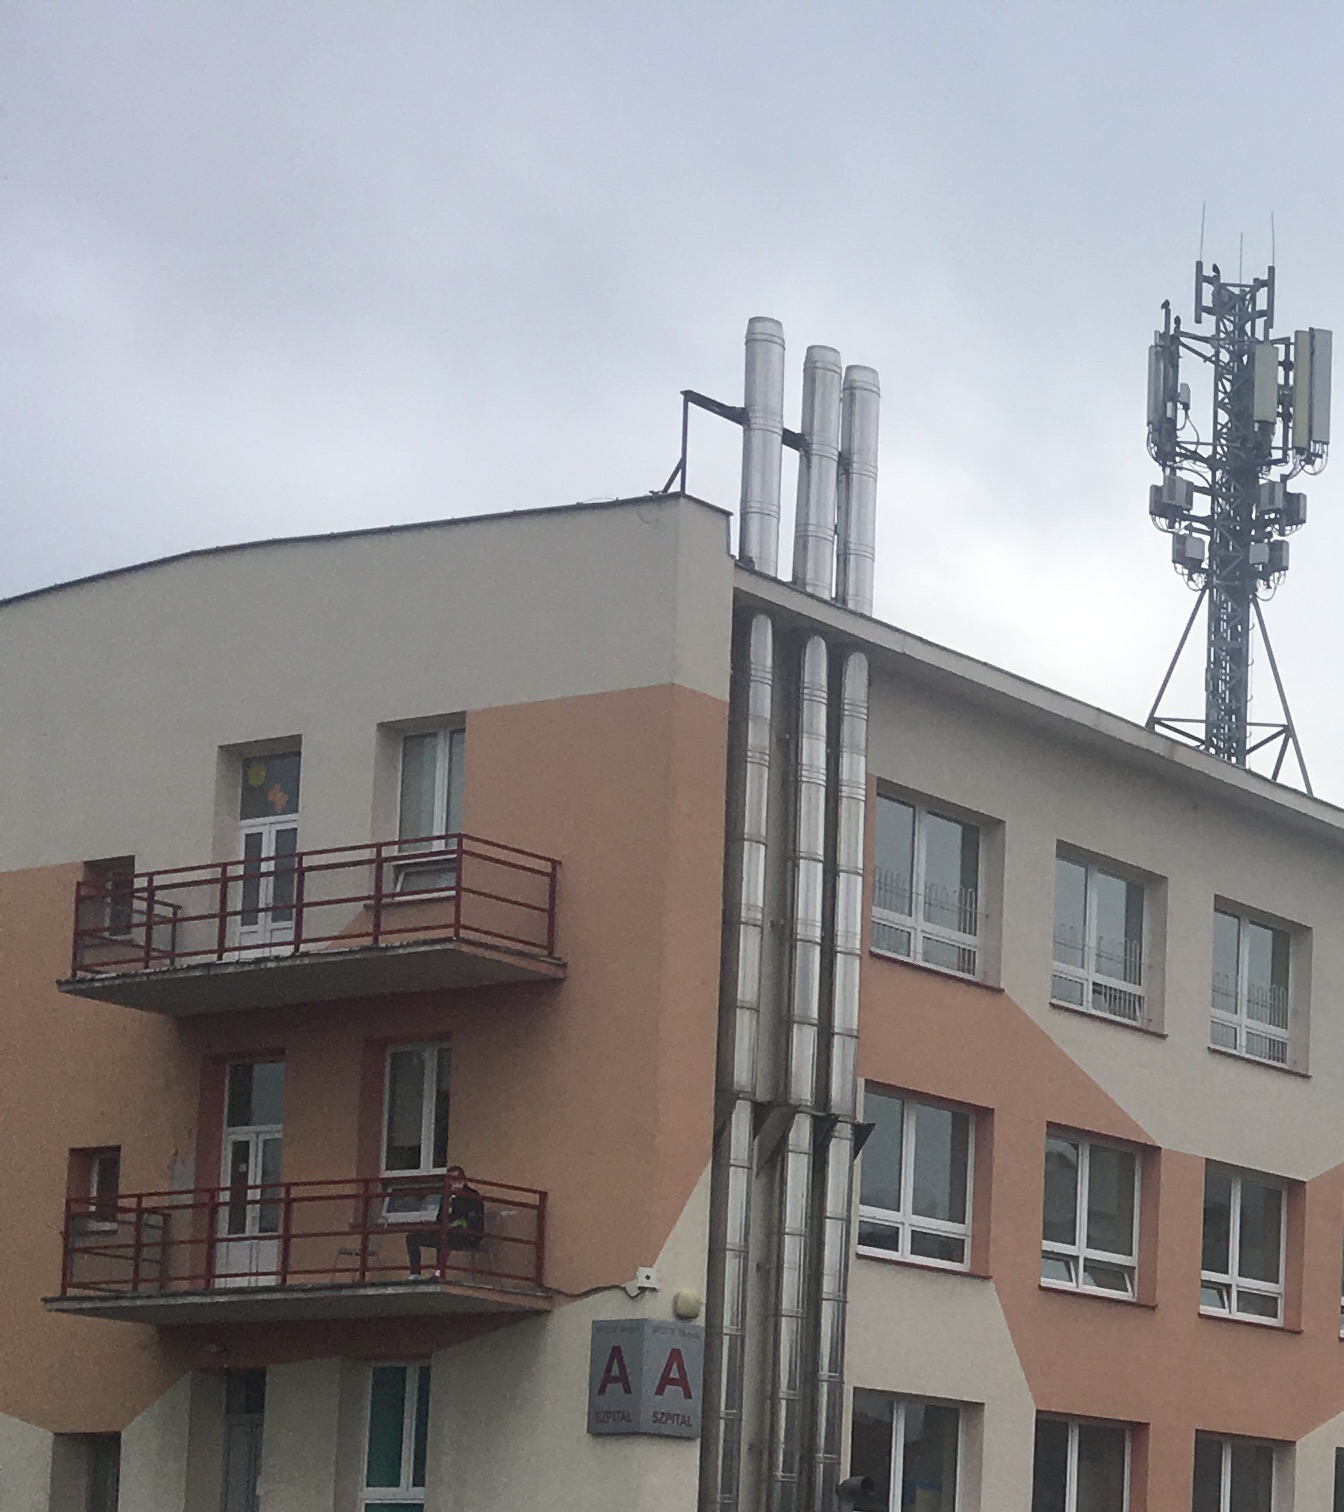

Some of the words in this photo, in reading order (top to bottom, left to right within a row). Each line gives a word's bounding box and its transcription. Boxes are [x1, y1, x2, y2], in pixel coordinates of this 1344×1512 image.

[597, 1345, 632, 1396] A
[655, 1347, 693, 1400] A
[596, 1410, 633, 1424] SZPITAL
[653, 1411, 693, 1428] SZPITAL
